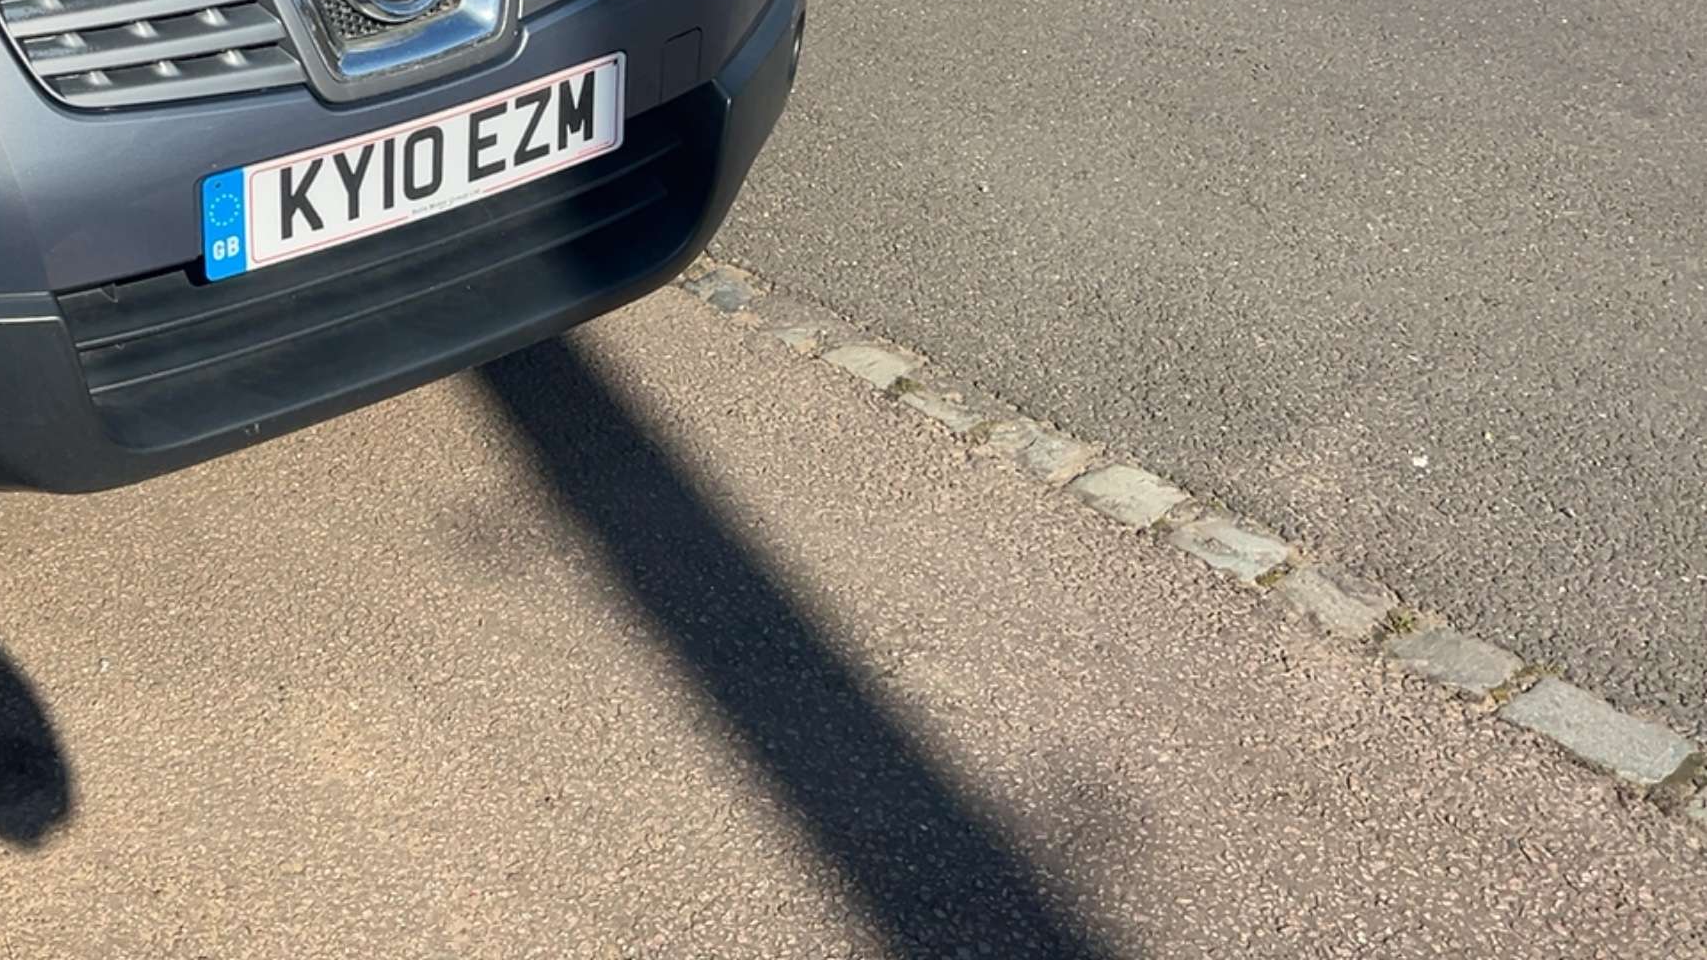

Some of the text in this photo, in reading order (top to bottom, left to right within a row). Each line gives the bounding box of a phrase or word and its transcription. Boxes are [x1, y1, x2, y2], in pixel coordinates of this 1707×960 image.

[280, 71, 595, 240] KY10 EZM
[213, 235, 240, 261] GB
